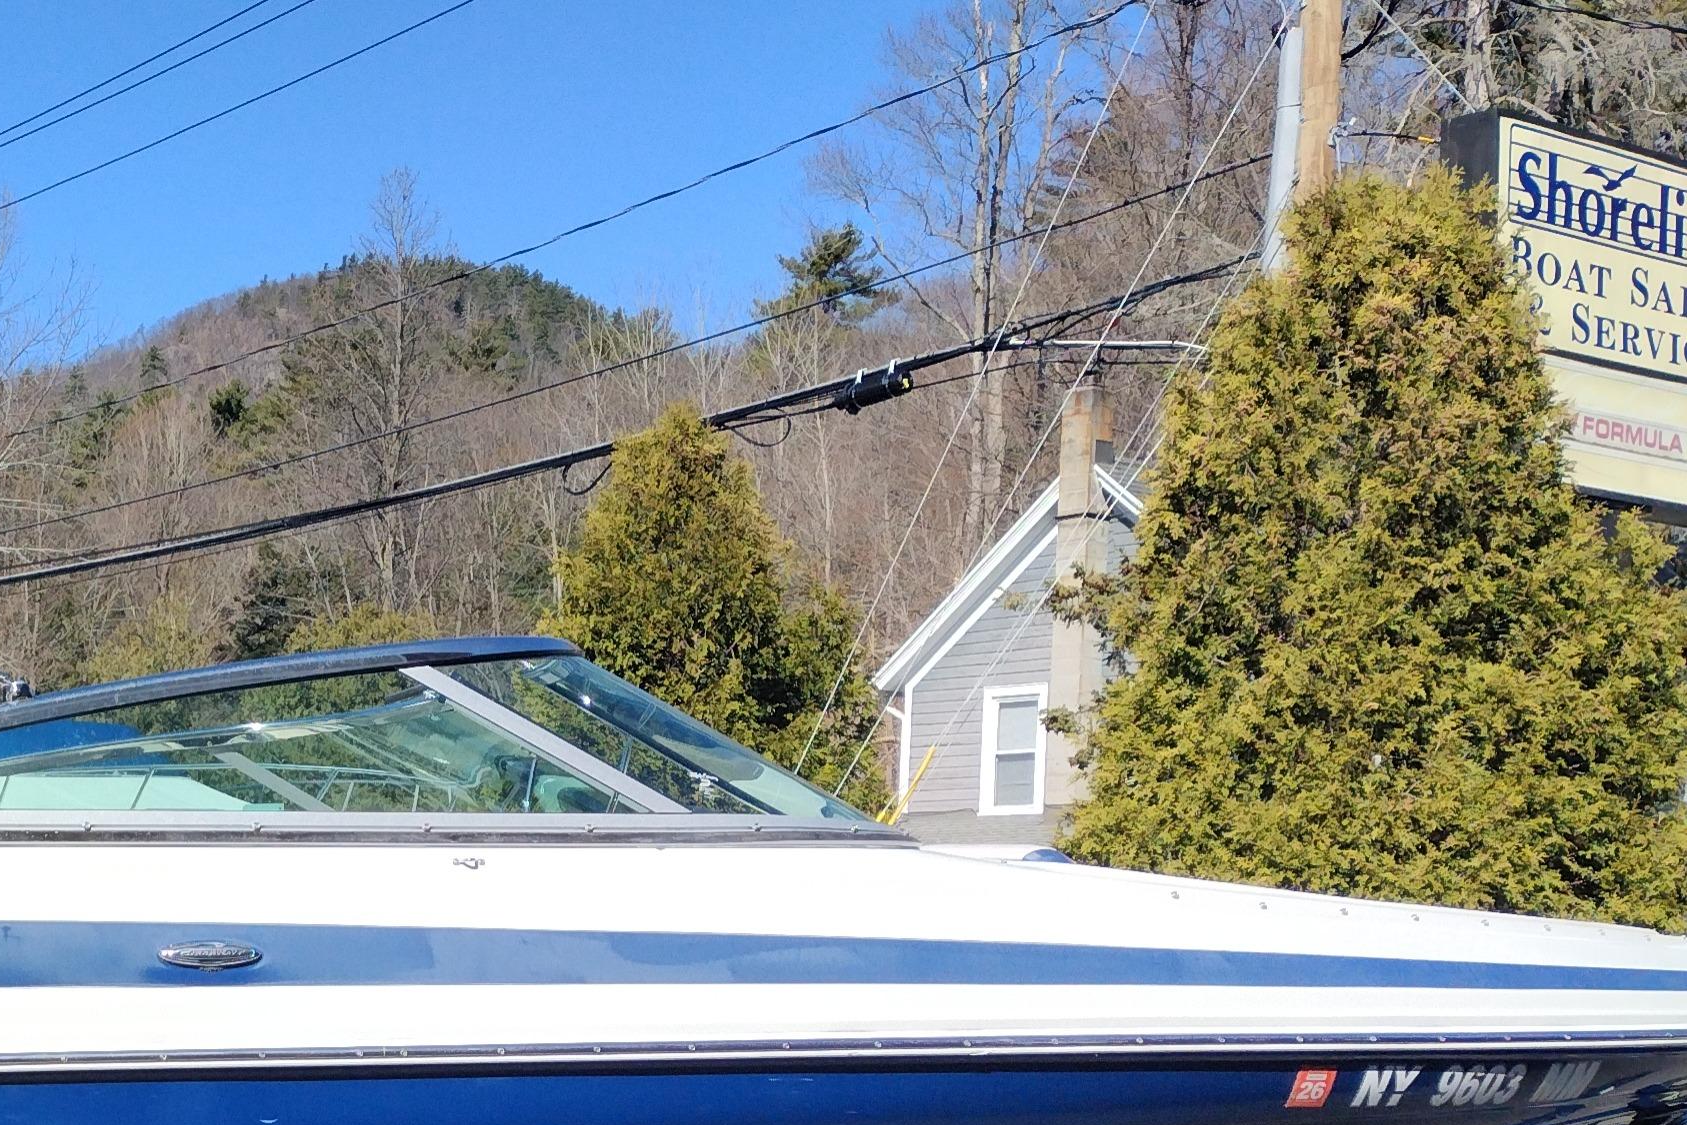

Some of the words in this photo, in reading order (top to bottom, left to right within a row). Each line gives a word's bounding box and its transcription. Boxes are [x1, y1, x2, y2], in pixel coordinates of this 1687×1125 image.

[1510, 236, 1612, 298] BOAT
[1571, 303, 1687, 365] SERVI
[1582, 415, 1683, 454] FORMULA
[1296, 1081, 1327, 1101] 26
[1350, 1065, 1423, 1108] NY
[1429, 1064, 1527, 1107] 9603
